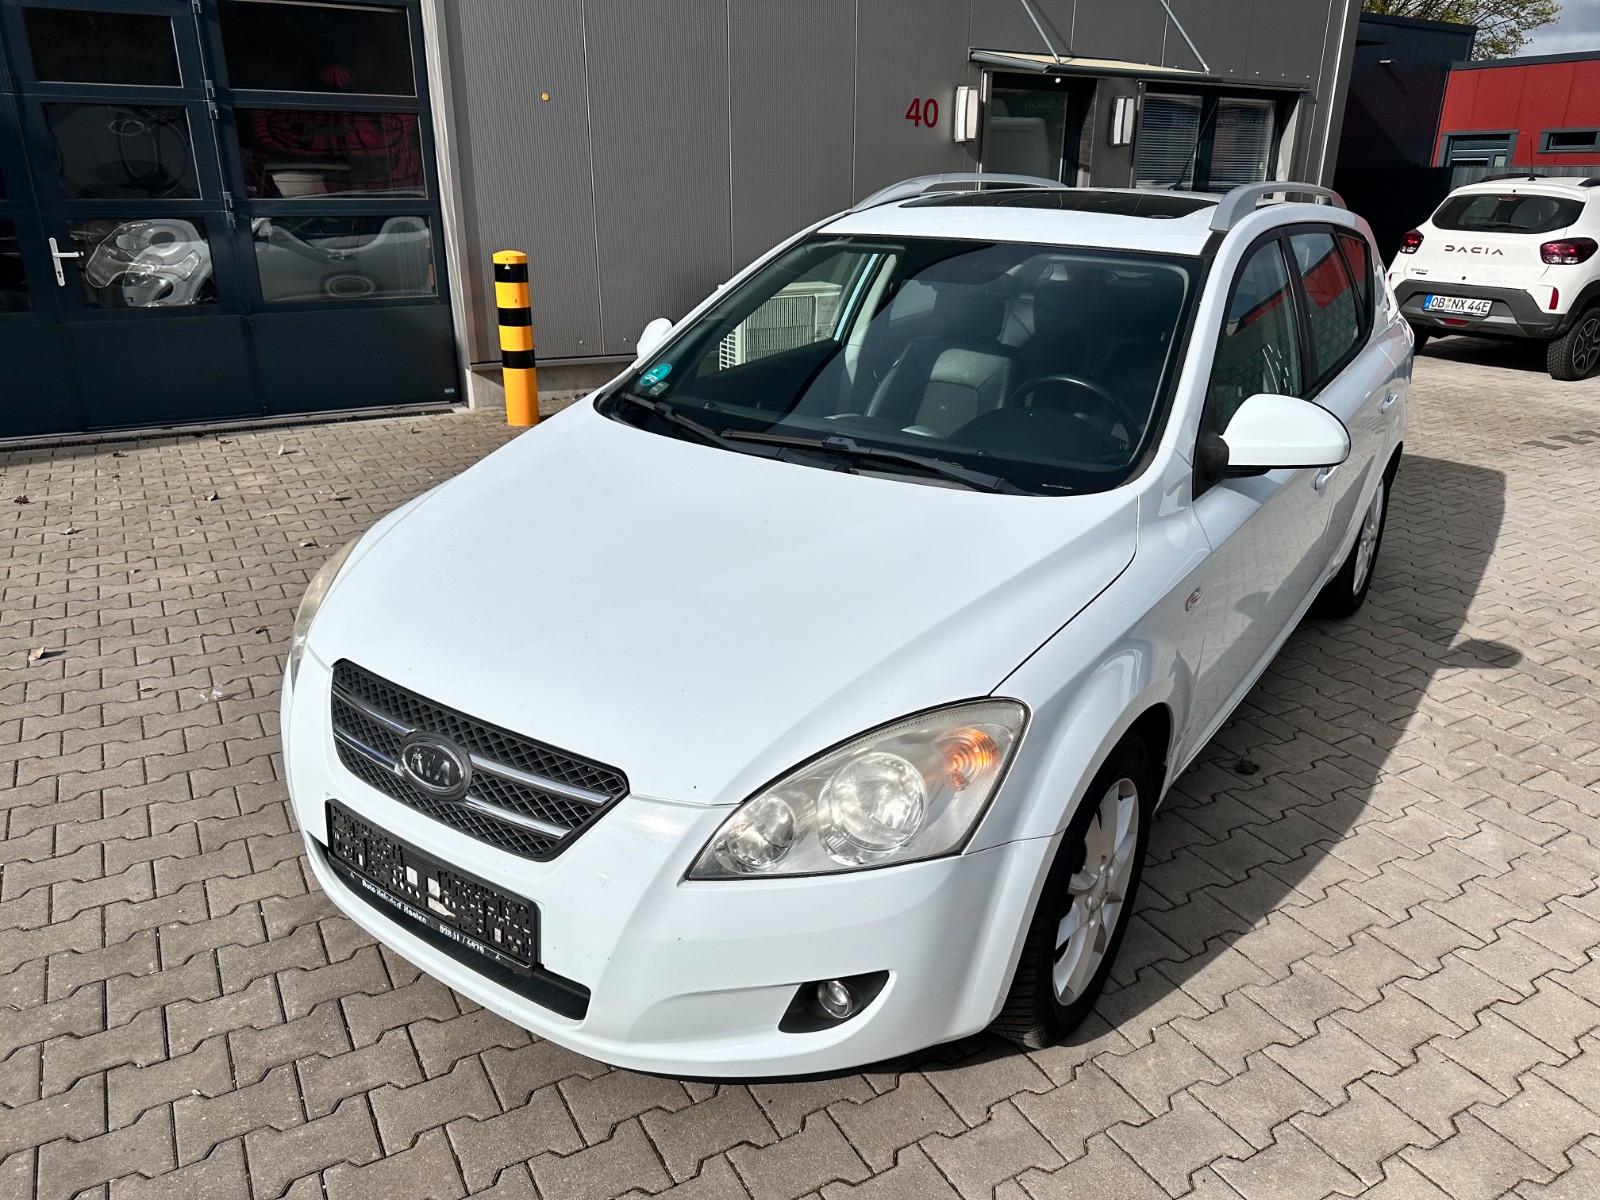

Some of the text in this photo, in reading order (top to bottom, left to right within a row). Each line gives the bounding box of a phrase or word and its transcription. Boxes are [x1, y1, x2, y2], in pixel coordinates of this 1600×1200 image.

[904, 97, 939, 128] 40
[1444, 245, 1504, 256] DACIA
[1431, 297, 1490, 313] OB NX 44E
